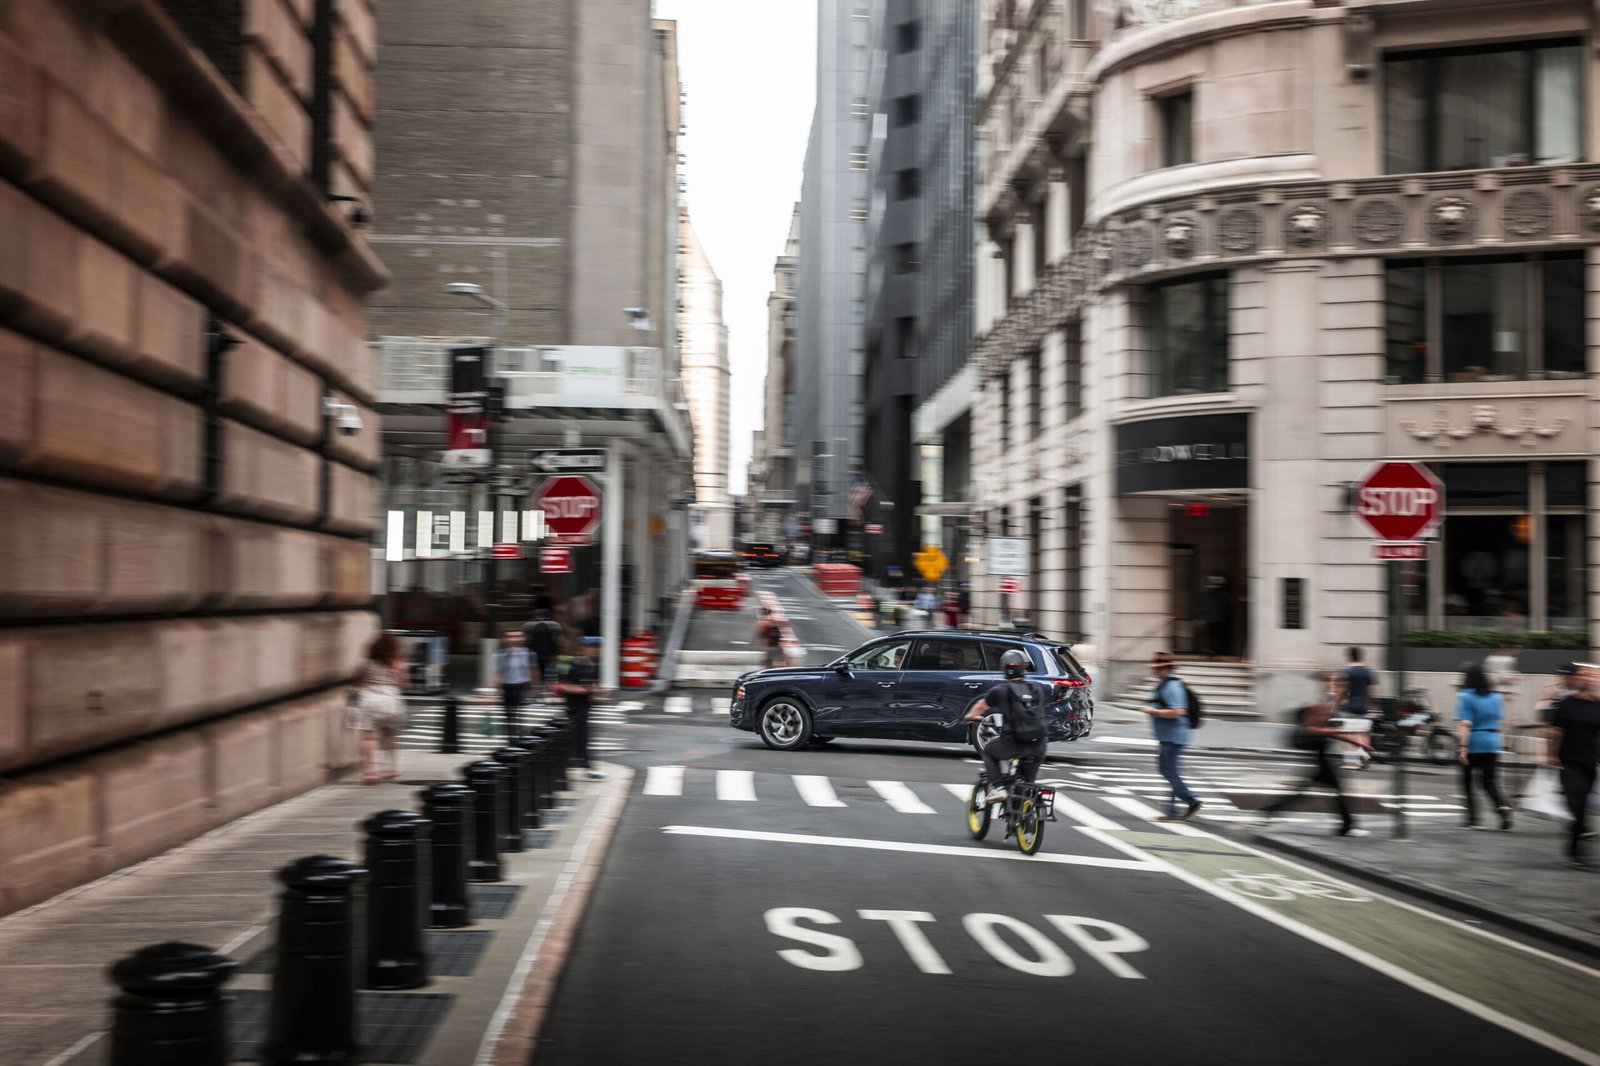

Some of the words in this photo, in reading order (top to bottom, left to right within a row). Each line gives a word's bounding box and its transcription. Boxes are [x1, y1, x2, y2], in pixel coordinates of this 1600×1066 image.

[539, 496, 598, 518] STOP
[1358, 487, 1438, 516] STOP
[763, 906, 1150, 979] STOP
